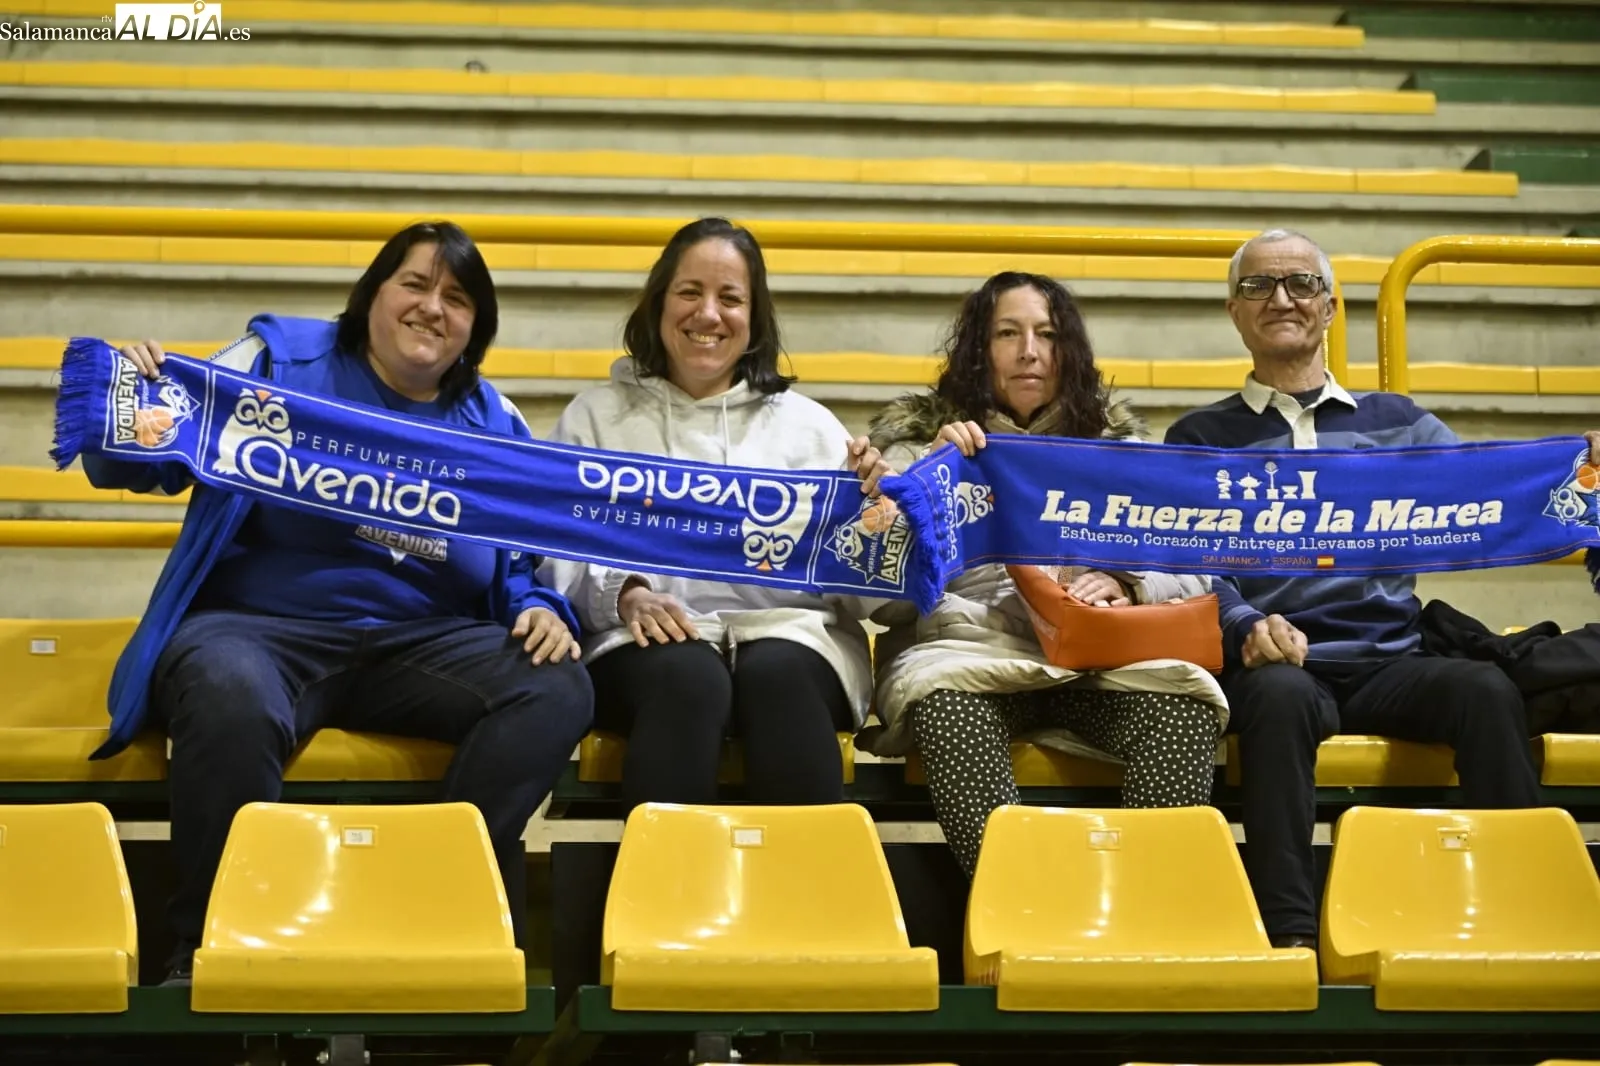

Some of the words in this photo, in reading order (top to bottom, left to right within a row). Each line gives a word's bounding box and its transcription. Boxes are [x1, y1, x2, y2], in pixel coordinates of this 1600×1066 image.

[117, 359, 138, 441] AVENIDA
[296, 432, 467, 480] PERFUMERÍAS
[241, 440, 461, 526] avenida
[578, 460, 791, 523] avenida
[573, 504, 739, 537] PERFUMERÍAS
[1040, 490, 1091, 524] La
[1100, 494, 1243, 533] Fuerza
[1253, 501, 1306, 534] de
[1314, 501, 1354, 533] la
[1364, 498, 1503, 532] Marea
[357, 525, 447, 559] AVENIDA
[880, 514, 909, 581] AVENID
[1060, 526, 1138, 546] Esfuerzo,
[1143, 532, 1208, 548] Corazón
[1213, 538, 1223, 551] y
[1228, 536, 1294, 552] Entrega
[1299, 536, 1375, 551] llevamos
[1380, 536, 1409, 551] por
[1412, 530, 1481, 546] bandera
[1202, 554, 1261, 565] SALAMANCA
[1272, 555, 1312, 566] ESPAÑA
